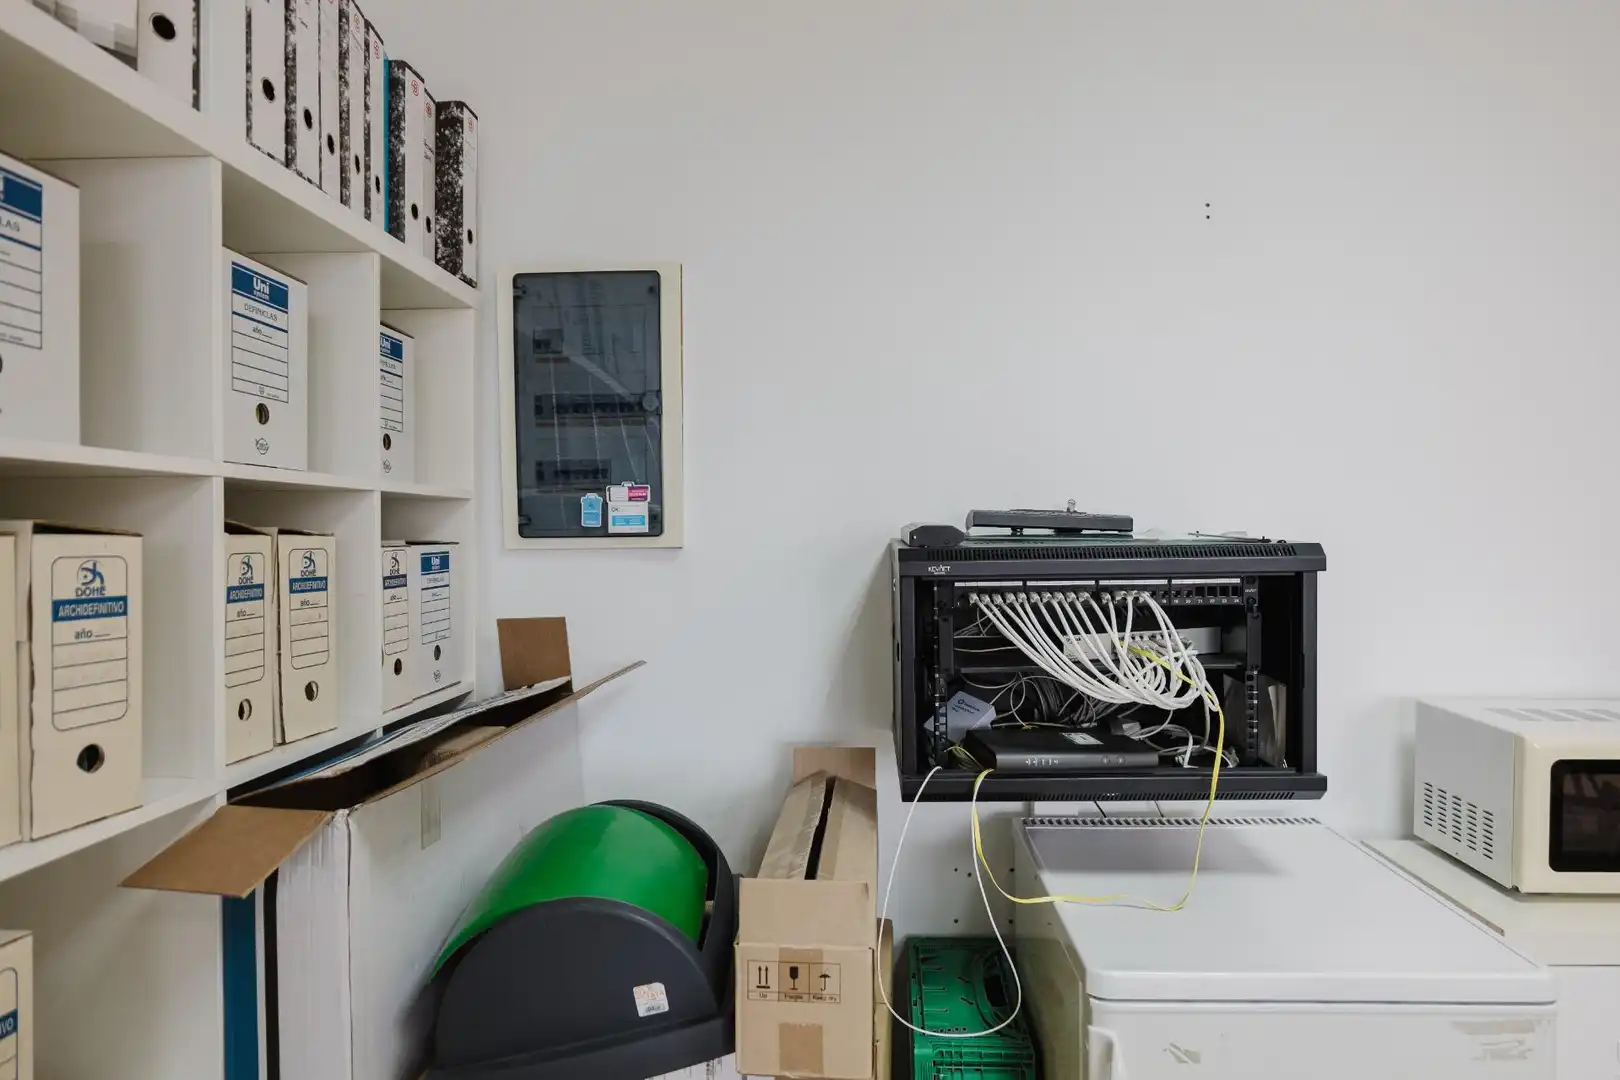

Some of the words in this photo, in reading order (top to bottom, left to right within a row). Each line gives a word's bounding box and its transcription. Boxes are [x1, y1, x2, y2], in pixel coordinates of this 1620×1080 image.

[253, 277, 270, 295] Uni
[300, 568, 317, 578] DOHE
[238, 576, 254, 585] DOHE
[75, 585, 106, 598] DOHE
[58, 600, 125, 618] ARCHIDEFINITIVO
[74, 628, 94, 640] año
